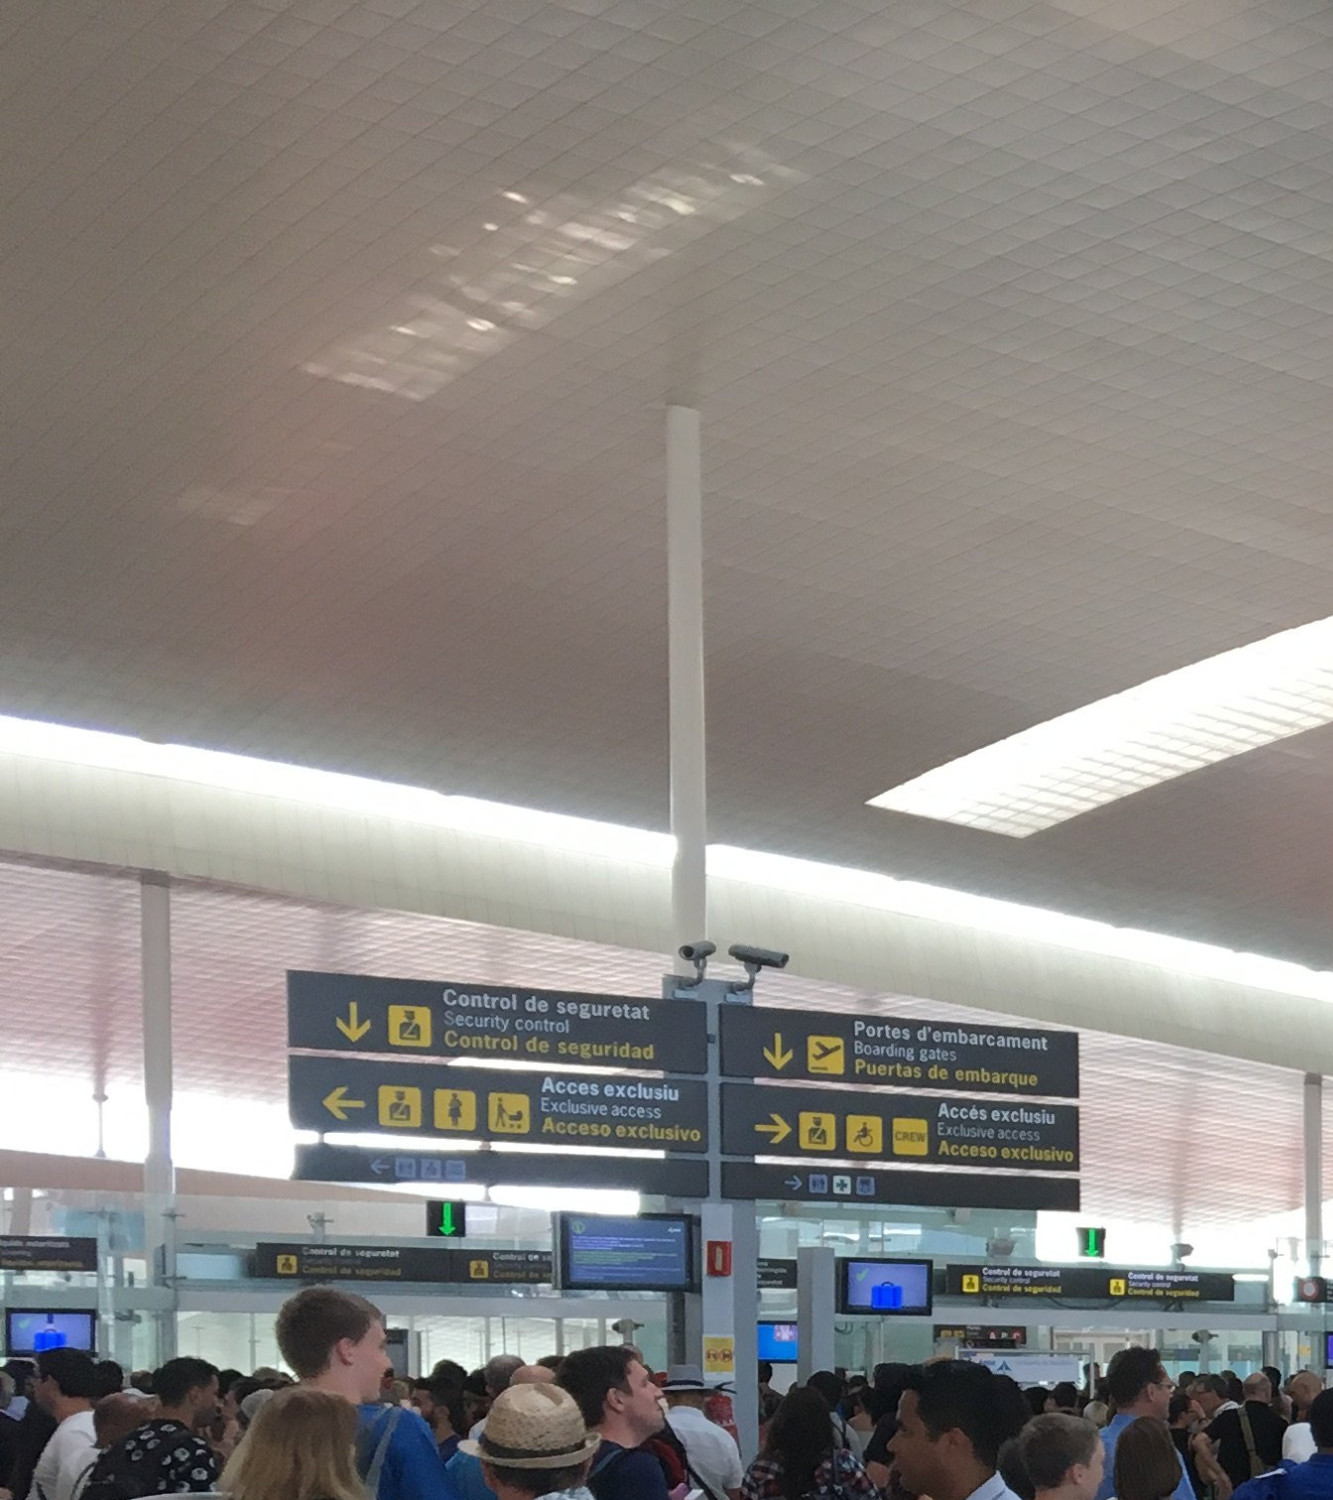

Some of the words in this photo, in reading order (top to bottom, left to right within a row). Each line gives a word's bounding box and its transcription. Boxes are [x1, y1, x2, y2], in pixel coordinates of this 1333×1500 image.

[443, 988, 517, 1011] Control
[524, 995, 549, 1013] de
[556, 1000, 650, 1021] seguretat
[444, 1010, 509, 1033] Security
[515, 1017, 570, 1034] control
[444, 1030, 518, 1052] Control
[525, 1037, 550, 1054] de
[557, 1041, 655, 1060] seguridad
[854, 1020, 911, 1041] Portes
[917, 1024, 1049, 1051] d'embarcament
[854, 1041, 915, 1062] Boarding
[919, 1048, 957, 1063] gates
[855, 1059, 922, 1079] Puertas
[928, 1065, 949, 1081] de
[954, 1068, 1039, 1090] embarque
[603, 1082, 680, 1102] exclusiu
[540, 1097, 608, 1117] Exclusive
[611, 1104, 662, 1120] access
[991, 1108, 1056, 1126] exclusiu
[541, 1116, 611, 1138] Acceso
[615, 1123, 702, 1143] exclusivo
[895, 1130, 927, 1143] CREW
[937, 1121, 994, 1141] Exclusive
[997, 1128, 1041, 1142] access
[938, 1140, 997, 1159] Acceso
[1001, 1145, 1074, 1164] exclusivo
[982, 1267, 1011, 1276] Control
[1012, 1268, 1022, 1277] de
[982, 1283, 1011, 1292] Control
[1012, 1284, 1022, 1293] de
